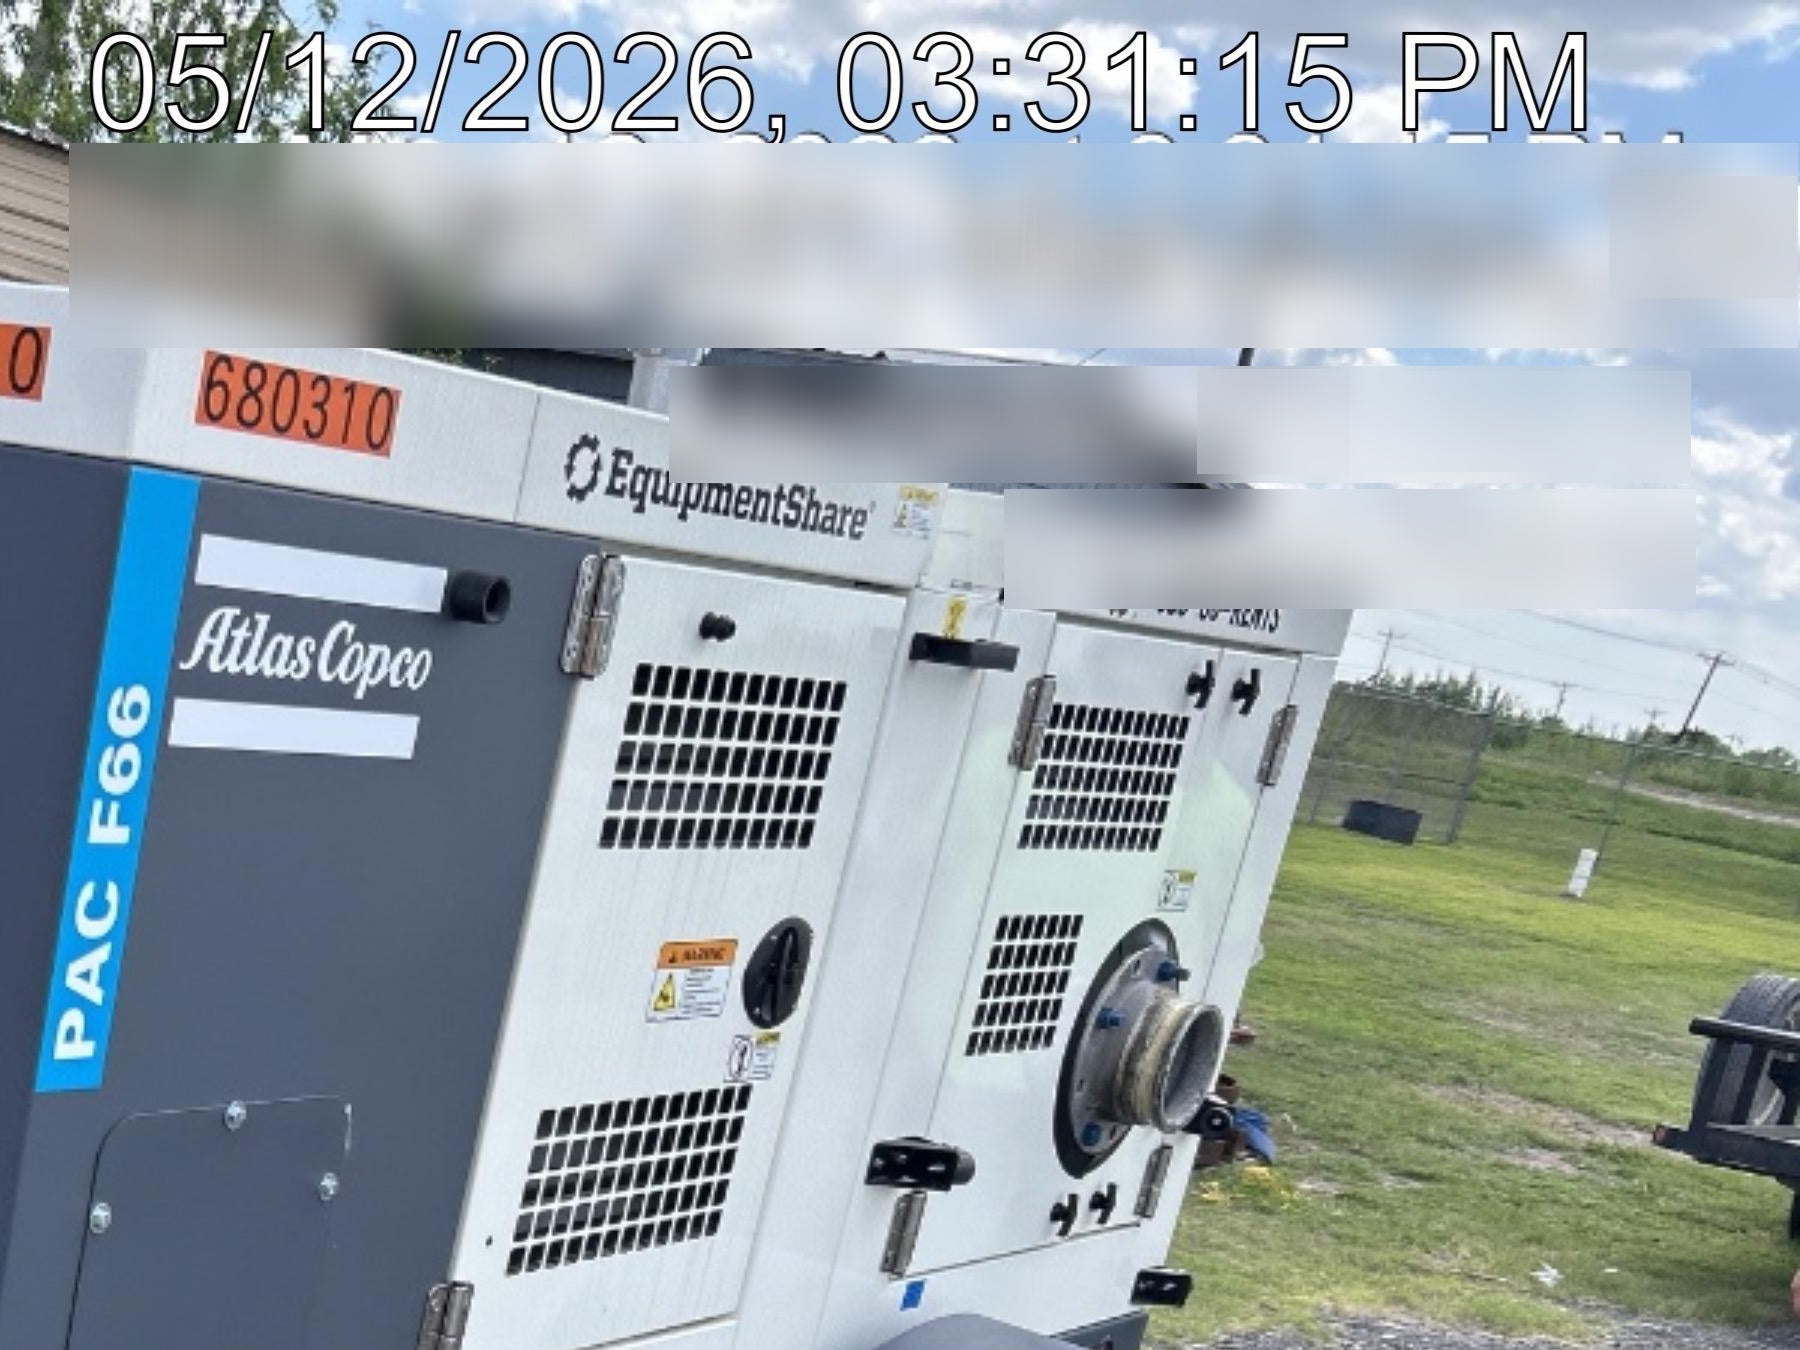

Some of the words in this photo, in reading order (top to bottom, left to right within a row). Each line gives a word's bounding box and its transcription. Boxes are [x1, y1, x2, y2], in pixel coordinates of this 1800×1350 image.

[203, 353, 395, 450] 680310
[179, 606, 316, 680] Atlas
[317, 620, 433, 700] Copco
[53, 879, 120, 1061] PAC
[87, 683, 151, 845] F66
